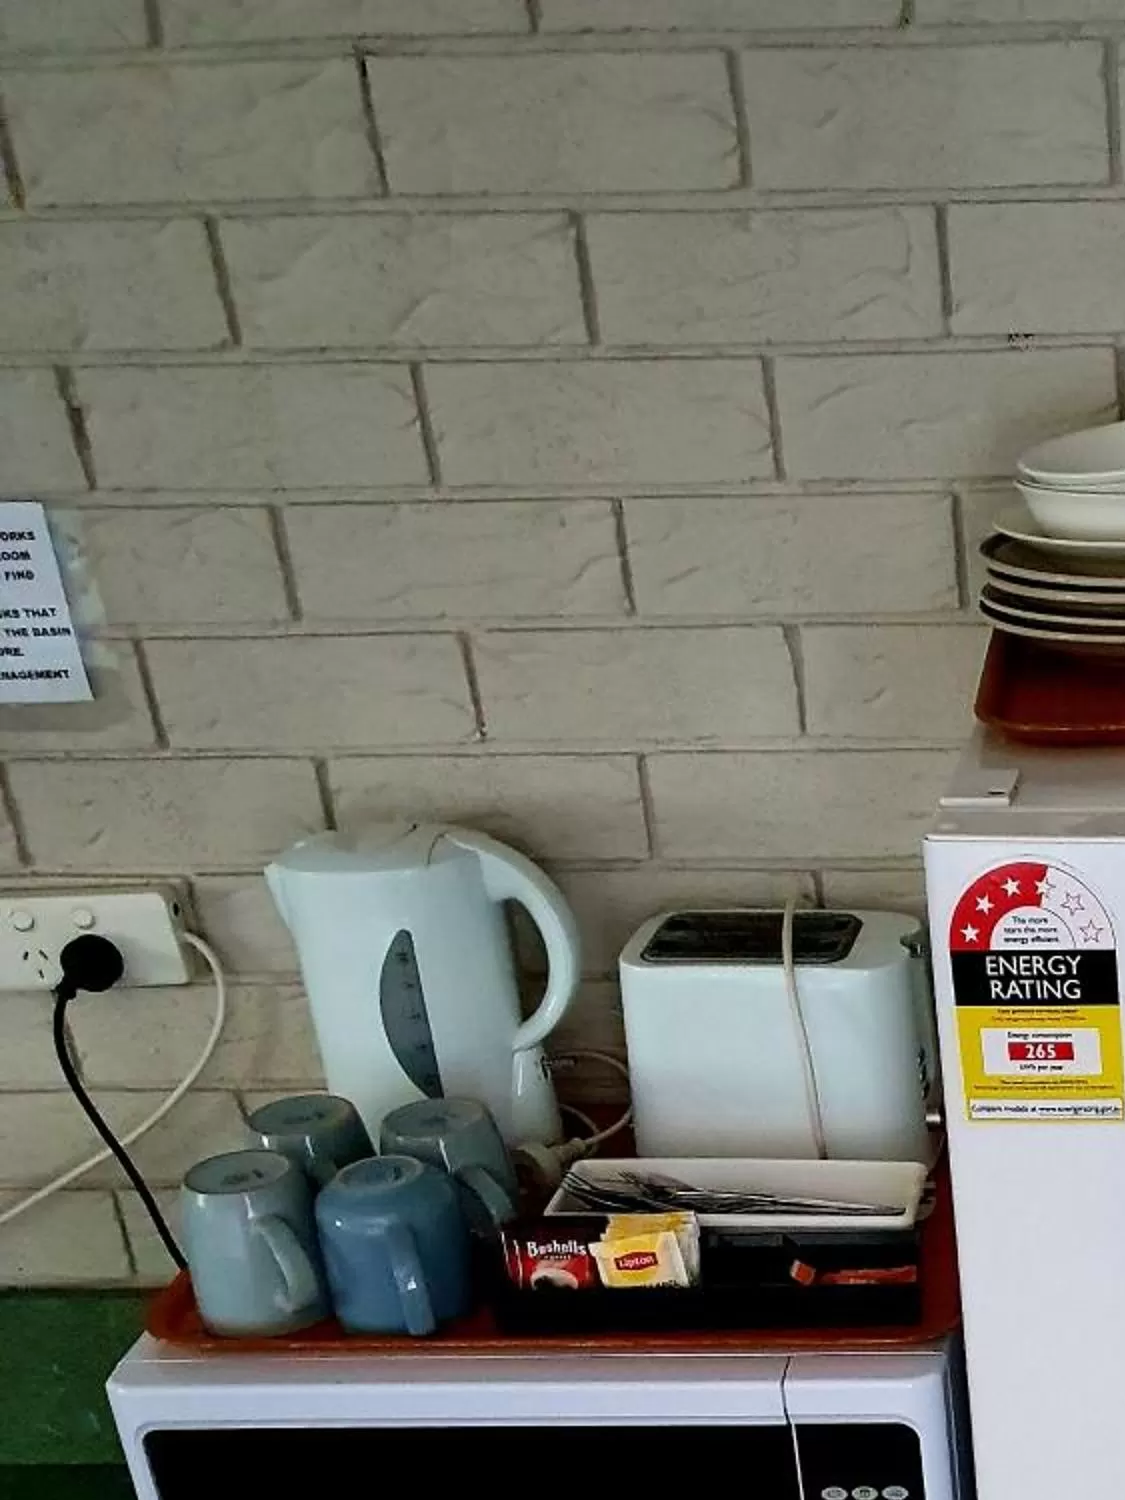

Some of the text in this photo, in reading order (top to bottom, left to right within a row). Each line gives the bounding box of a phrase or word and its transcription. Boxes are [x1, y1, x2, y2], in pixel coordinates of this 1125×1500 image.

[22, 607, 57, 618] THAT
[4, 627, 29, 637] THE
[985, 955, 1081, 976] ENERGY
[989, 979, 1081, 999] RATING
[1025, 1043, 1056, 1059] 265
[619, 1256, 656, 1268] Lipton
